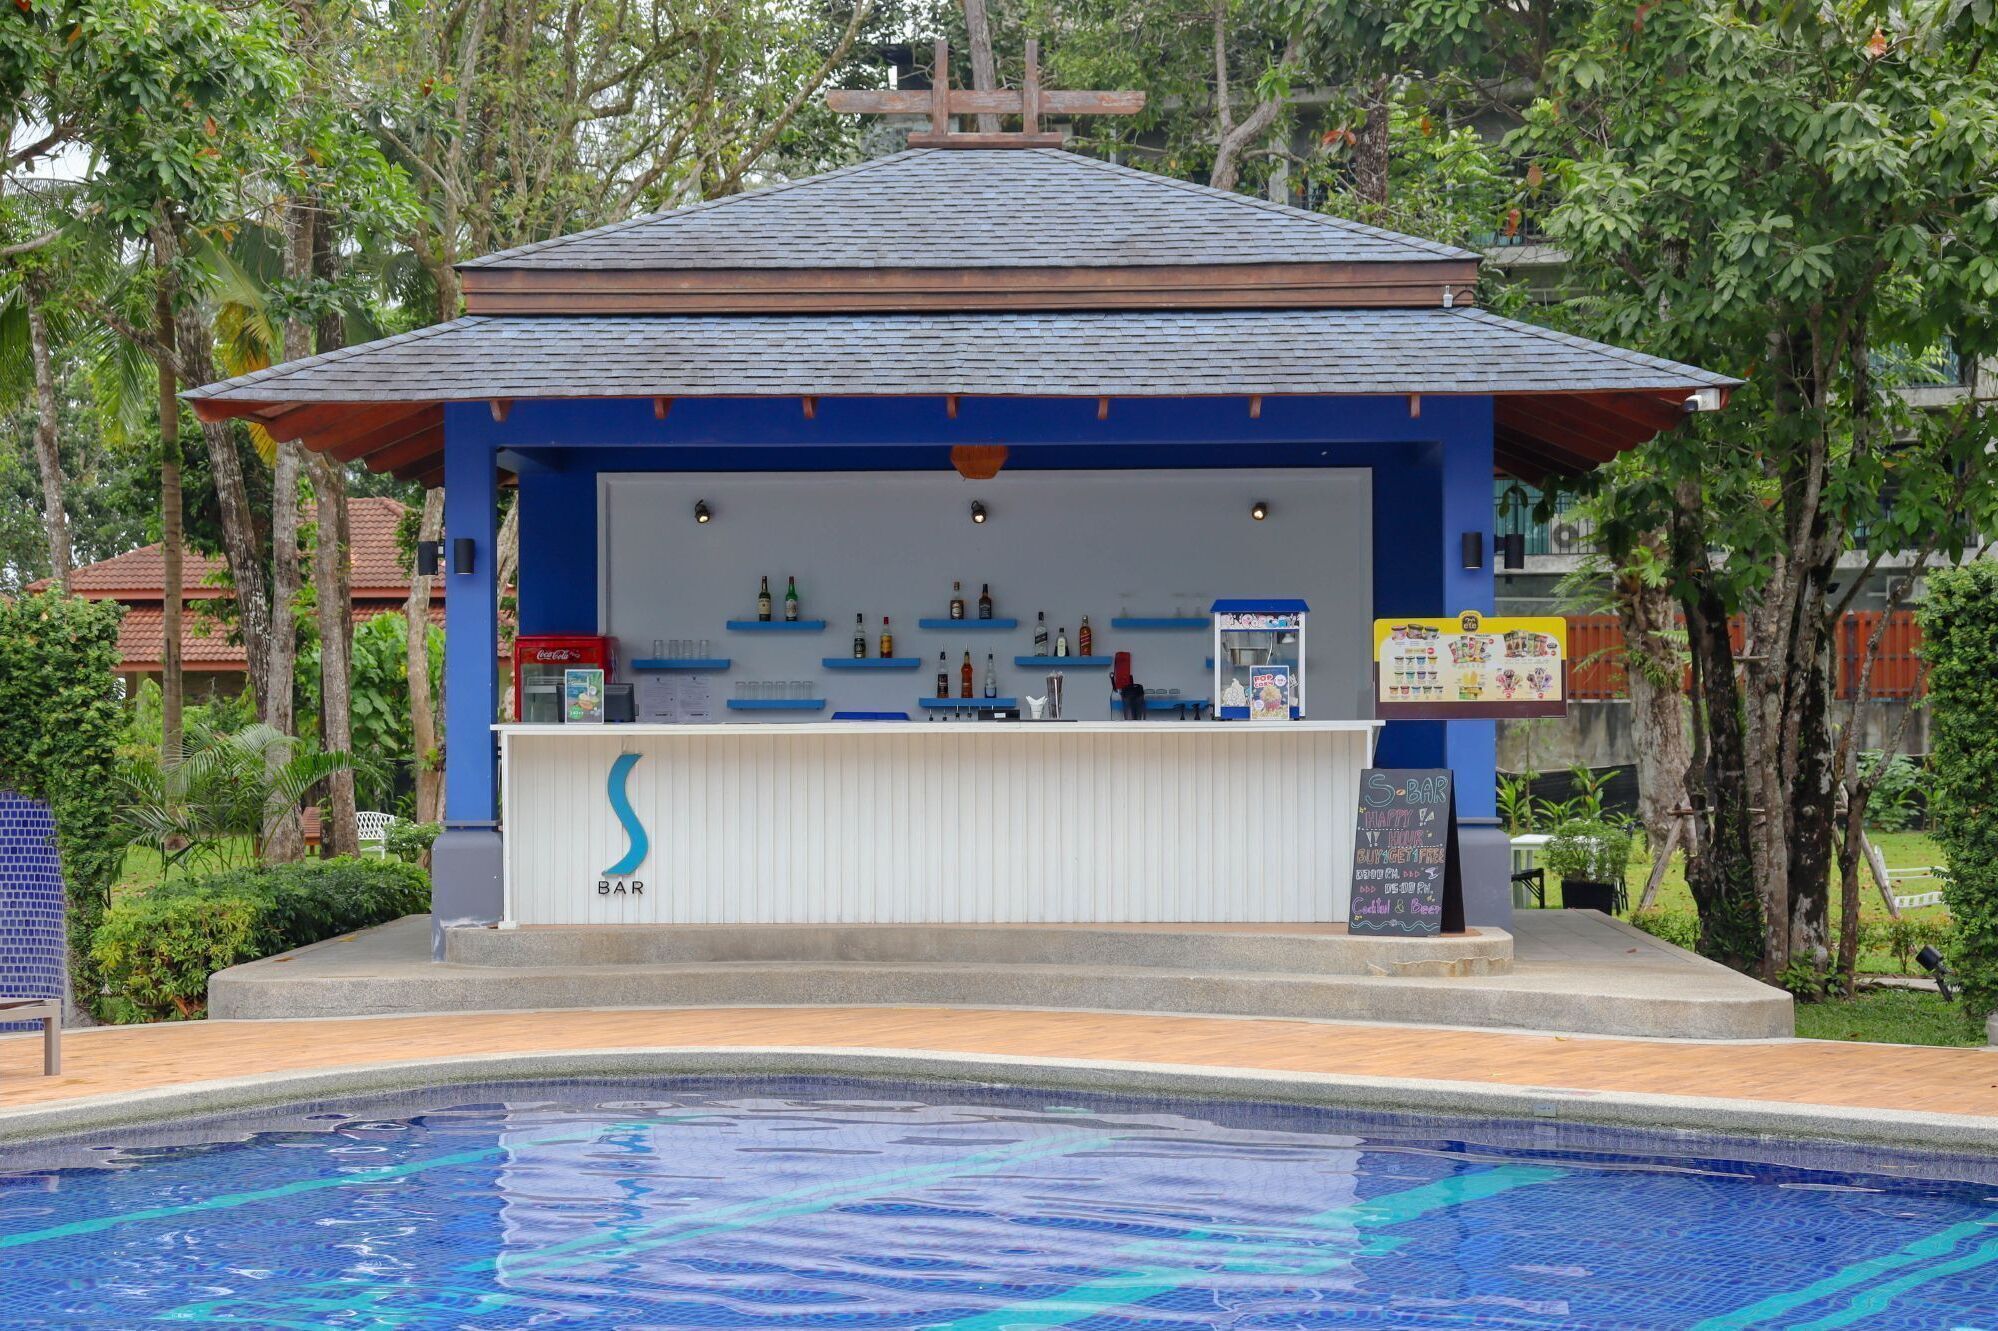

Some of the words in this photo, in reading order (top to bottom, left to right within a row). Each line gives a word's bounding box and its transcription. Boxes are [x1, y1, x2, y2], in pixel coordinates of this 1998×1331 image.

[1254, 675, 1273, 683] POP
[1365, 809, 1412, 828] HAPPY
[1388, 830, 1424, 847] HOUR
[598, 881, 644, 895] BAR
[1411, 897, 1442, 914] Beer
